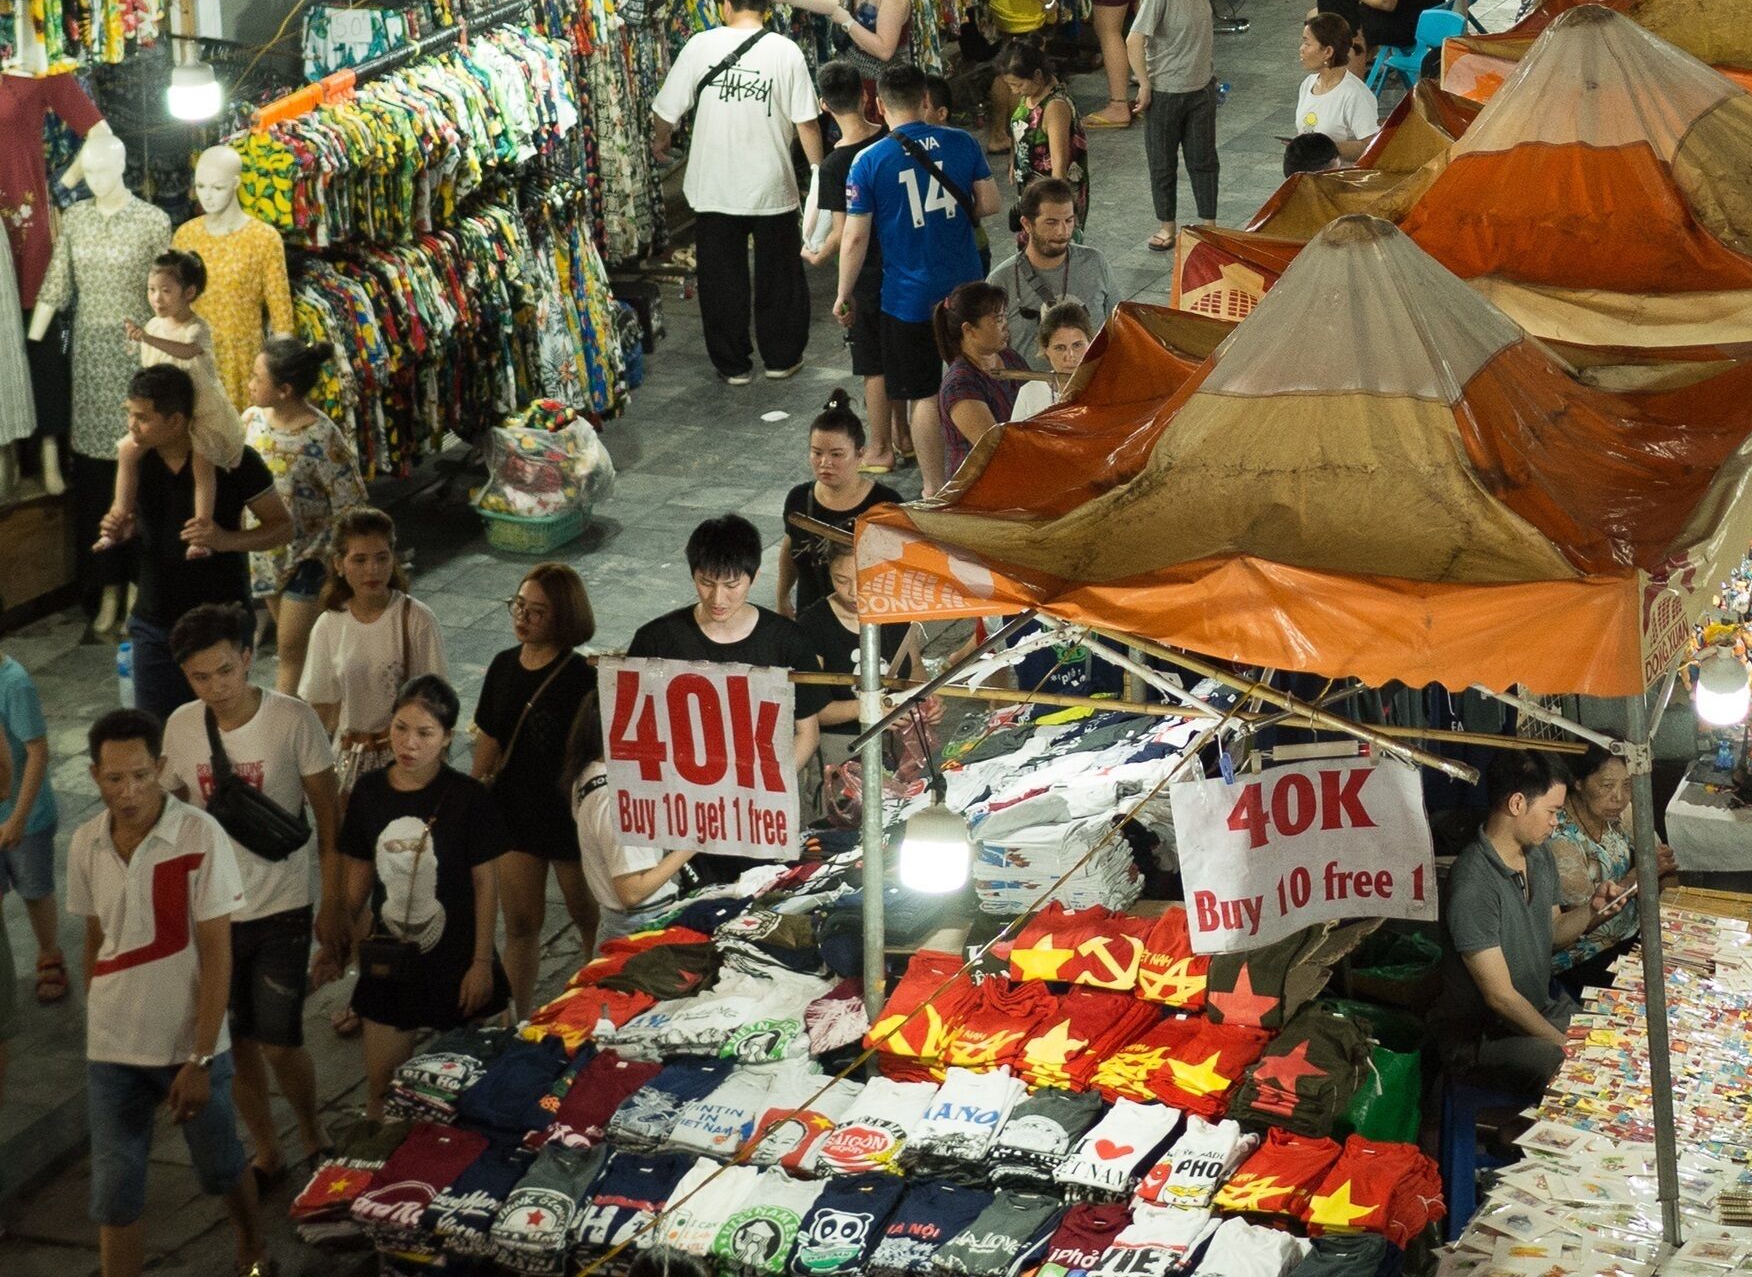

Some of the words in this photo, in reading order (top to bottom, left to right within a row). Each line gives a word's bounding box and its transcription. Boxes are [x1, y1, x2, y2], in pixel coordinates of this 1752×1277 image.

[898, 160, 959, 229] 14
[616, 788, 656, 841] Buy
[662, 791, 689, 838] 10
[694, 795, 727, 845] get
[732, 796, 742, 842] 1
[747, 797, 788, 847] free
[1226, 767, 1378, 850] 40K
[1193, 889, 1264, 937] Buy
[1276, 865, 1312, 917] 10
[1322, 860, 1394, 902] free
[1410, 862, 1426, 902] 1
[700, 1113, 719, 1122] IN
[1075, 1138, 1093, 1155] I
